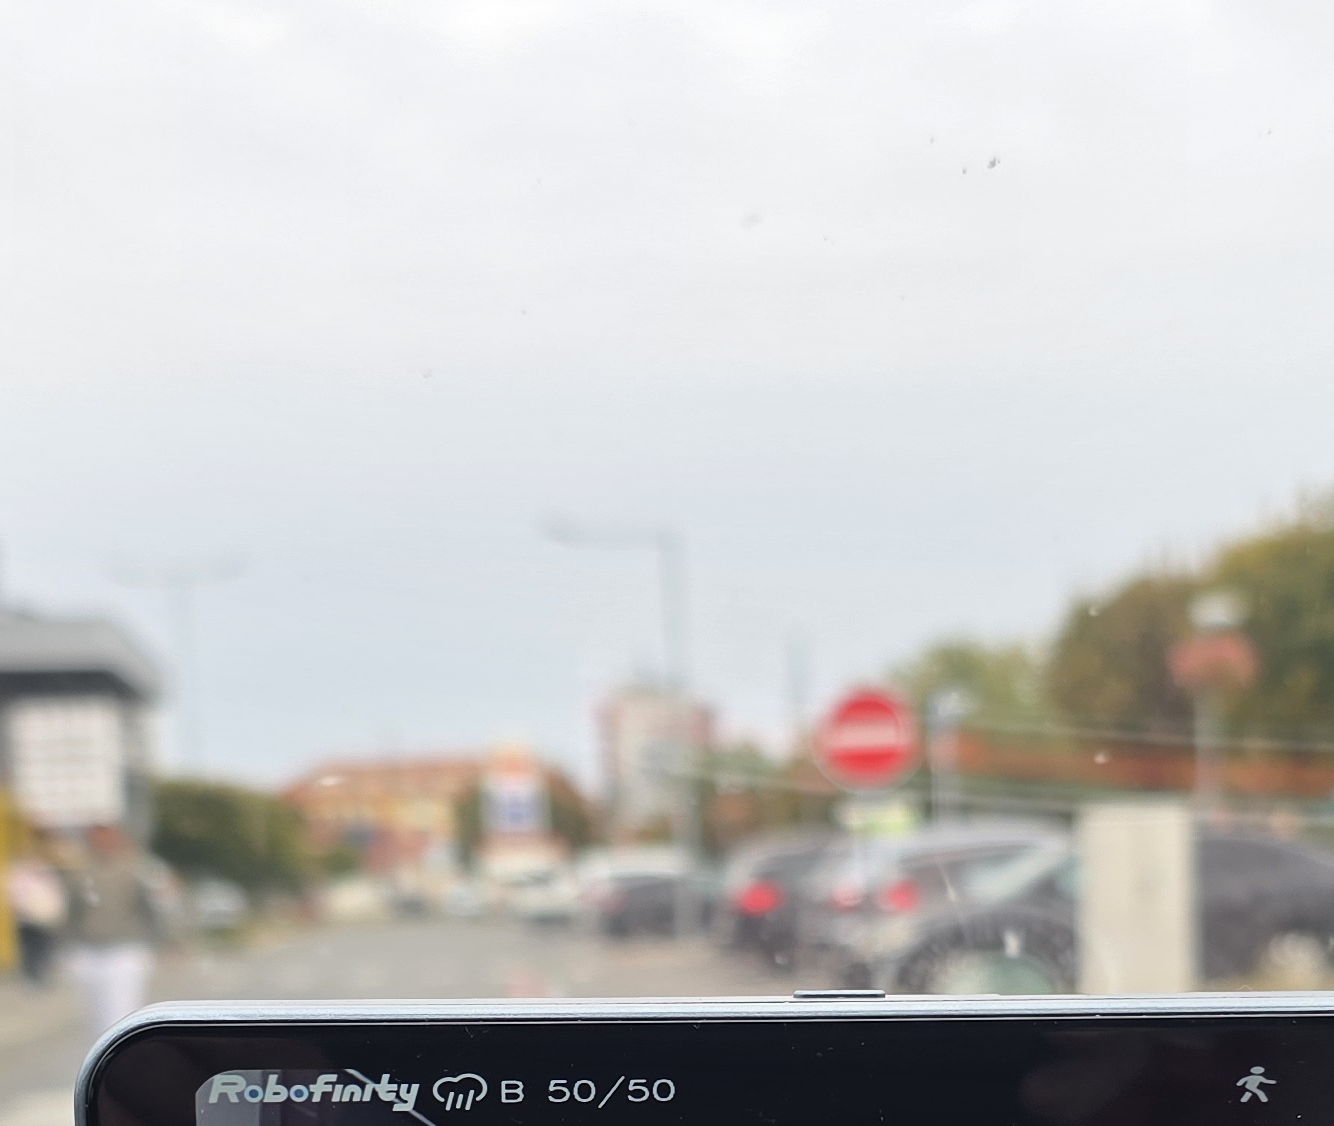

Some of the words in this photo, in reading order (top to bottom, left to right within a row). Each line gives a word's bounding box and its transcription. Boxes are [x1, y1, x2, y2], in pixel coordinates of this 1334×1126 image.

[208, 1073, 420, 1112] Robofinity
[500, 1080, 524, 1103] B
[547, 1075, 676, 1109] 50/50
